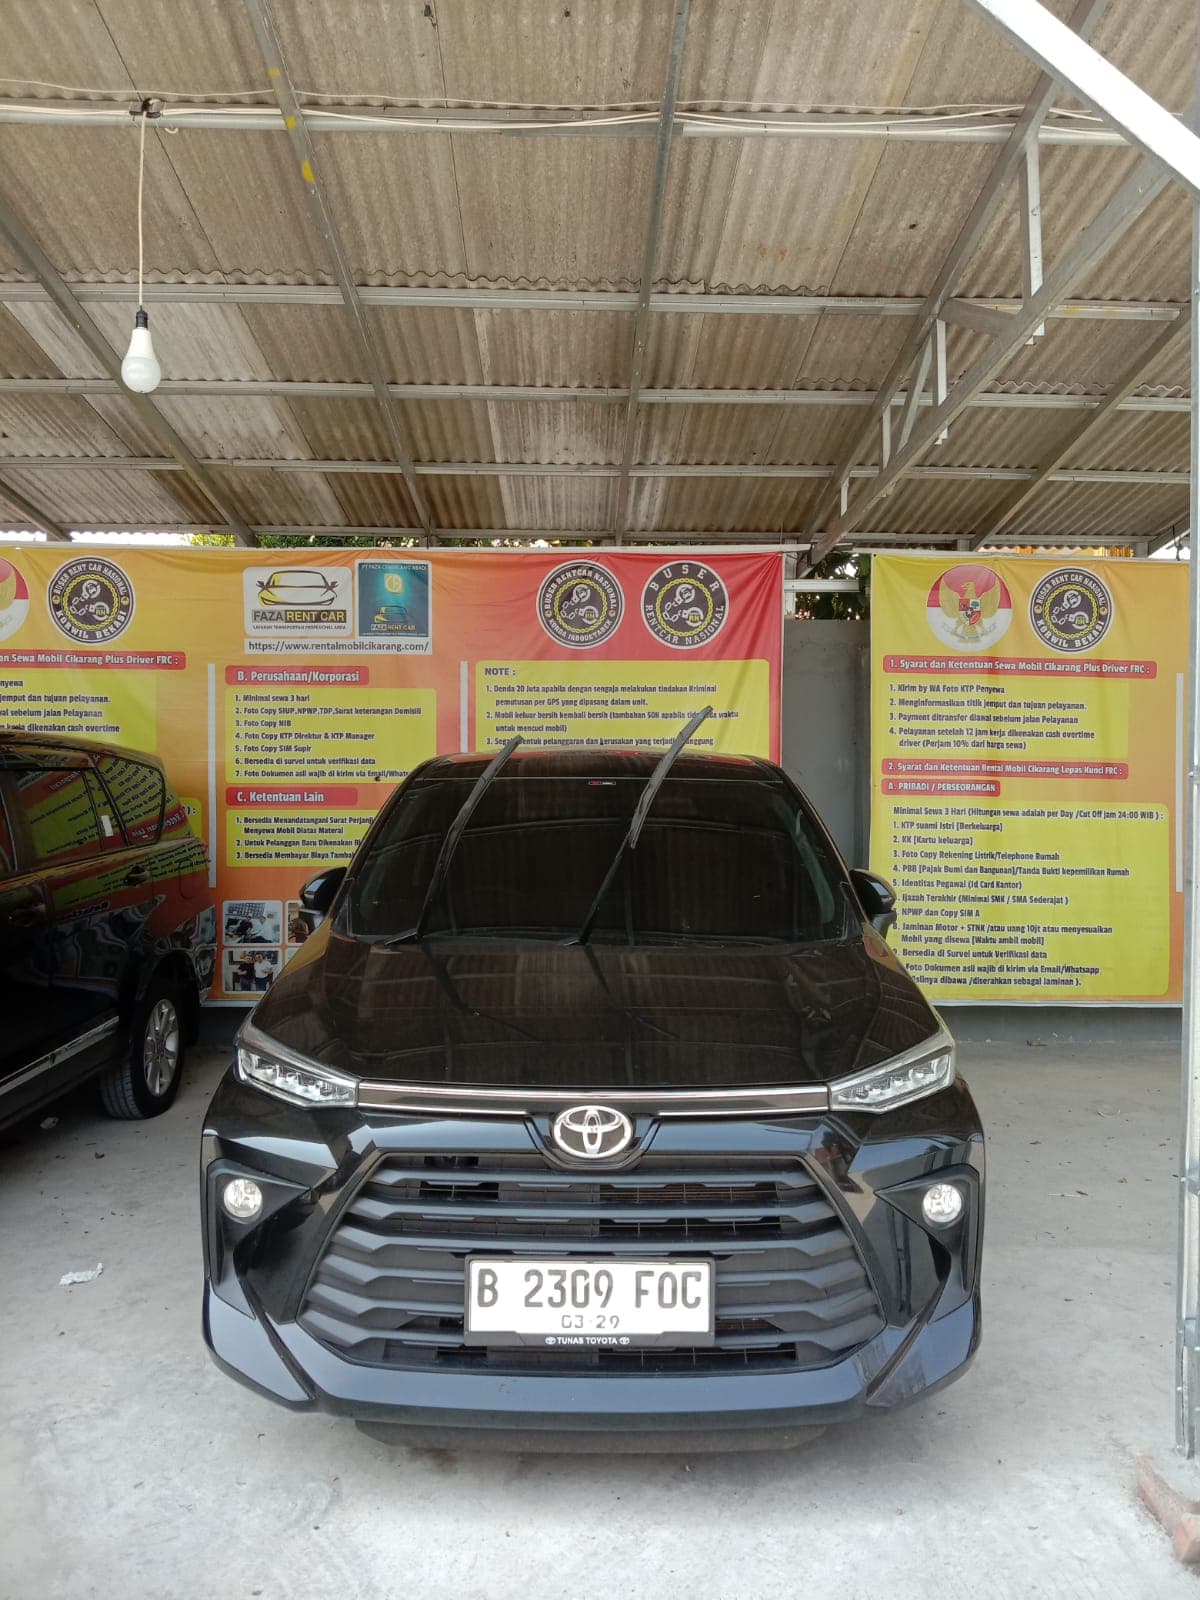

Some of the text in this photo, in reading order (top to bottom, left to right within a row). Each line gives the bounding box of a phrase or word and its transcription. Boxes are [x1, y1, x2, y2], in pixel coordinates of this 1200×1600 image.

[68, 564, 86, 576] RENT
[649, 564, 720, 591] BUSER
[1050, 574, 1069, 586] RENT
[594, 573, 617, 608] NASIONAL
[254, 611, 345, 621] FAZA RENT CAR
[56, 610, 127, 638] KORWIL BEKASI
[645, 605, 724, 645] RENTCAR NASIONAL
[1036, 619, 1105, 647] KORWIL BEKASI
[249, 641, 429, 652] https://www.rentalmobilcikarang.com/
[38, 654, 63, 663] Mobil
[65, 655, 103, 665] Cikarang
[105, 655, 125, 664] Plus
[126, 656, 154, 664] Driver
[156, 656, 173, 664] FRC
[900, 660, 927, 669] Syarat
[930, 660, 945, 668] dan
[949, 661, 993, 669] Ketentuan
[994, 661, 1016, 670] Sewa
[1044, 663, 1081, 672] Cikarang
[1083, 663, 1101, 671] Plus
[1102, 664, 1128, 673] Driver
[1130, 665, 1144, 673] FRC
[237, 671, 359, 683] B. Perusahaan/Korporasi
[541, 685, 566, 694] apabila
[567, 685, 592, 694] dengan
[594, 685, 619, 693] sengaja
[918, 684, 927, 693] by
[976, 685, 1005, 694] Penyewa
[44, 695, 67, 704] tujuan
[69, 695, 111, 704] pelayanan.
[898, 699, 965, 707] Menginformasikan
[983, 700, 1006, 708] jemput
[1023, 702, 1046, 710] tujuan
[1047, 702, 1087, 711] pelayanan.
[10, 709, 42, 717] sebelum
[43, 709, 62, 718] jalan
[63, 709, 103, 718] Pelayanan
[27, 724, 66, 732] dikenakan
[85, 725, 120, 733] overtime
[898, 728, 936, 736] Pelayanan
[989, 729, 1006, 737] kerja
[1007, 730, 1044, 738] dikenakan
[1062, 731, 1095, 739] overtime
[261, 733, 278, 741] Copy
[897, 763, 922, 771] Syarat
[1028, 766, 1059, 774] Cikarang
[1061, 766, 1083, 774] Lepas
[937, 783, 996, 791] PERSEORANGAN
[237, 792, 324, 802] C. Ketentuan Lain
[1060, 810, 1073, 819] Day
[1103, 811, 1117, 819] jam
[244, 827, 275, 835] Menyewa
[920, 851, 937, 859] Copy
[939, 851, 973, 860] Rekening
[977, 964, 996, 973] wajib
[1040, 966, 1100, 975] Email/Whatsapp
[477, 1268, 702, 1309] B 2309 FOC
